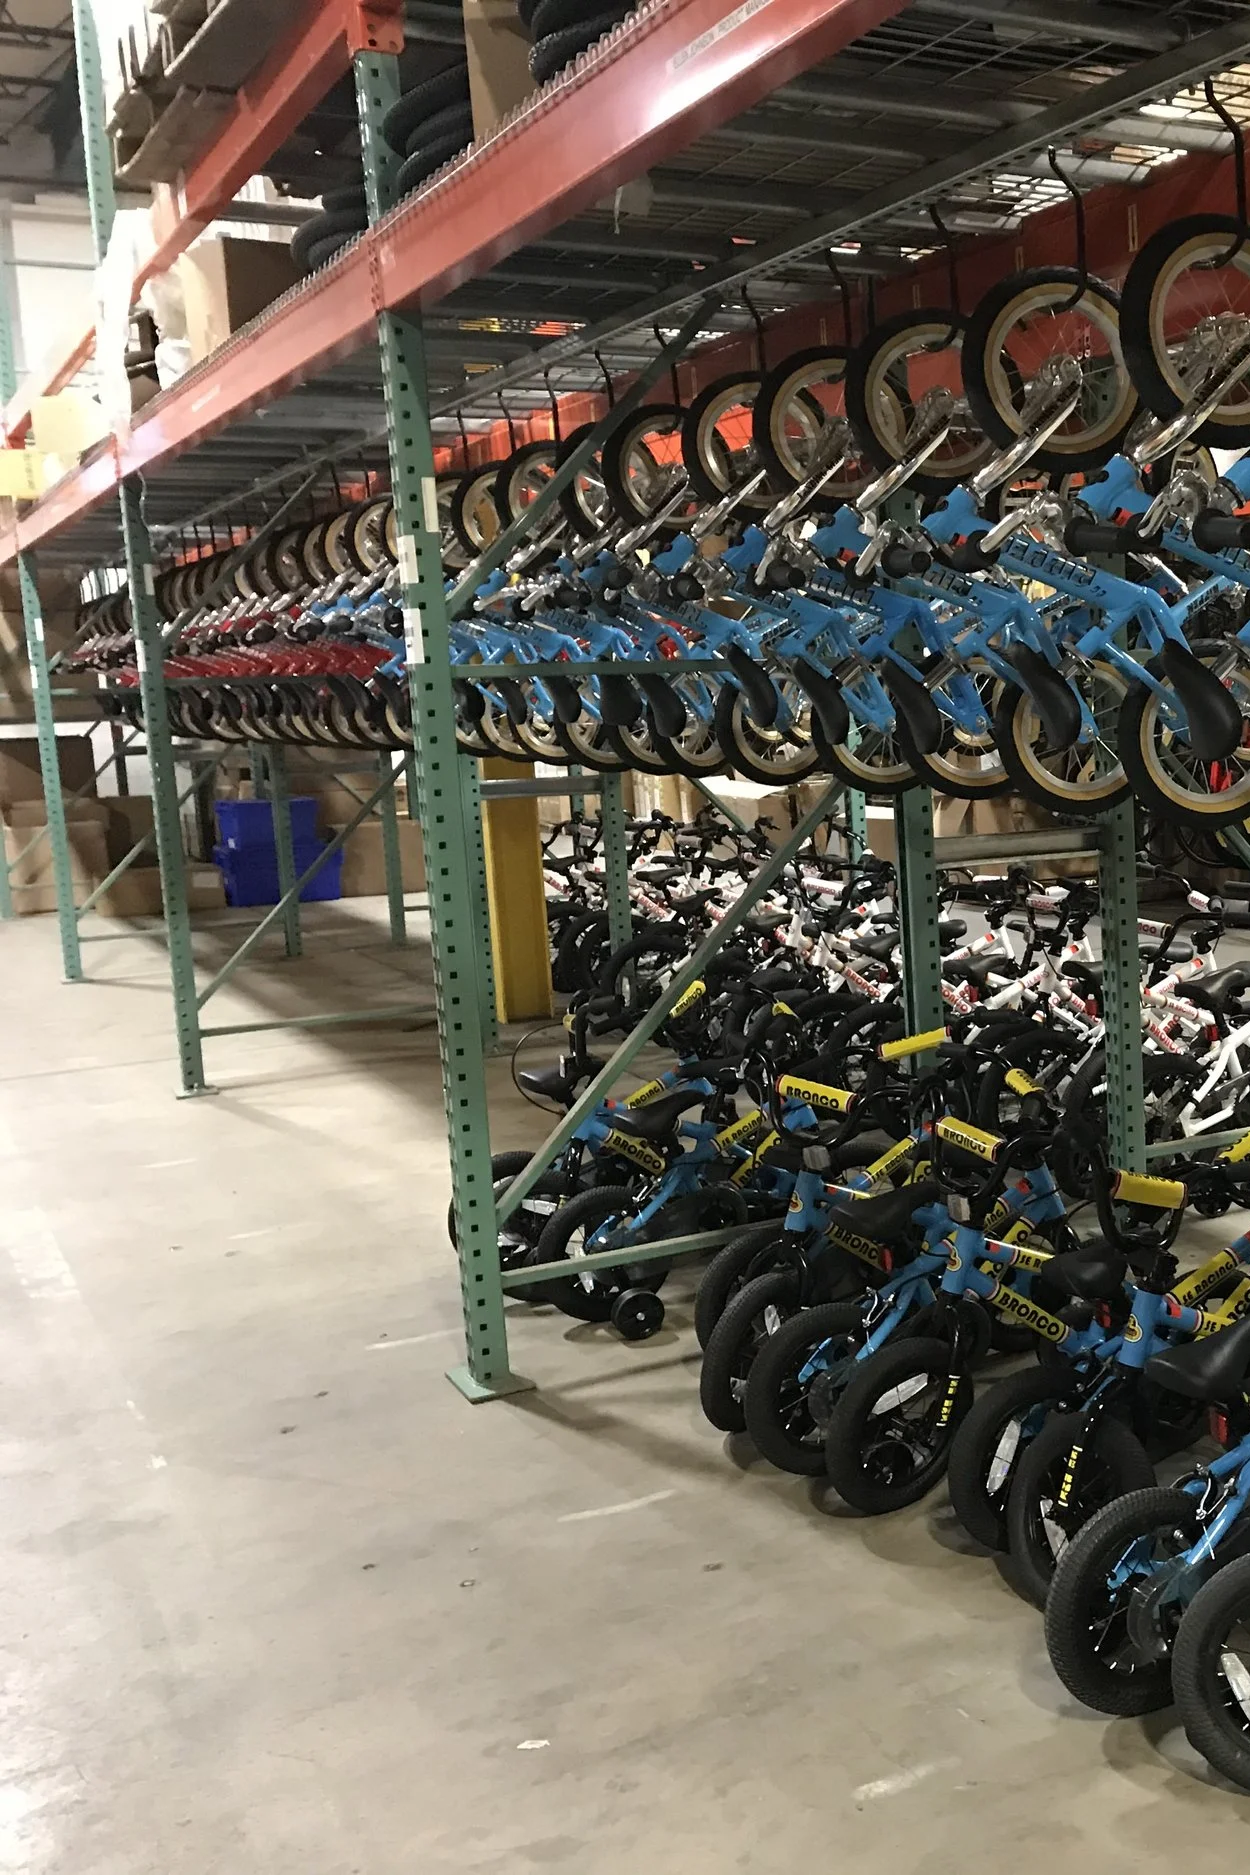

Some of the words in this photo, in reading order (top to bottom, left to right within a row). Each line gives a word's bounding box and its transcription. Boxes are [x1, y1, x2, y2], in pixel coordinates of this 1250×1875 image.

[845, 968, 881, 997] BRONCO
[787, 1086, 840, 1109] BRONCO
[731, 1115, 765, 1140] RACING
[943, 1128, 987, 1154] BRONCO
[613, 1135, 662, 1170] BRONCO
[834, 1224, 879, 1261] BRONC
[1182, 1290, 1194, 1304] SE
[1197, 1260, 1233, 1292] RACING
[999, 1292, 1060, 1336] BRONCO
[1203, 1318, 1217, 1333] SE
